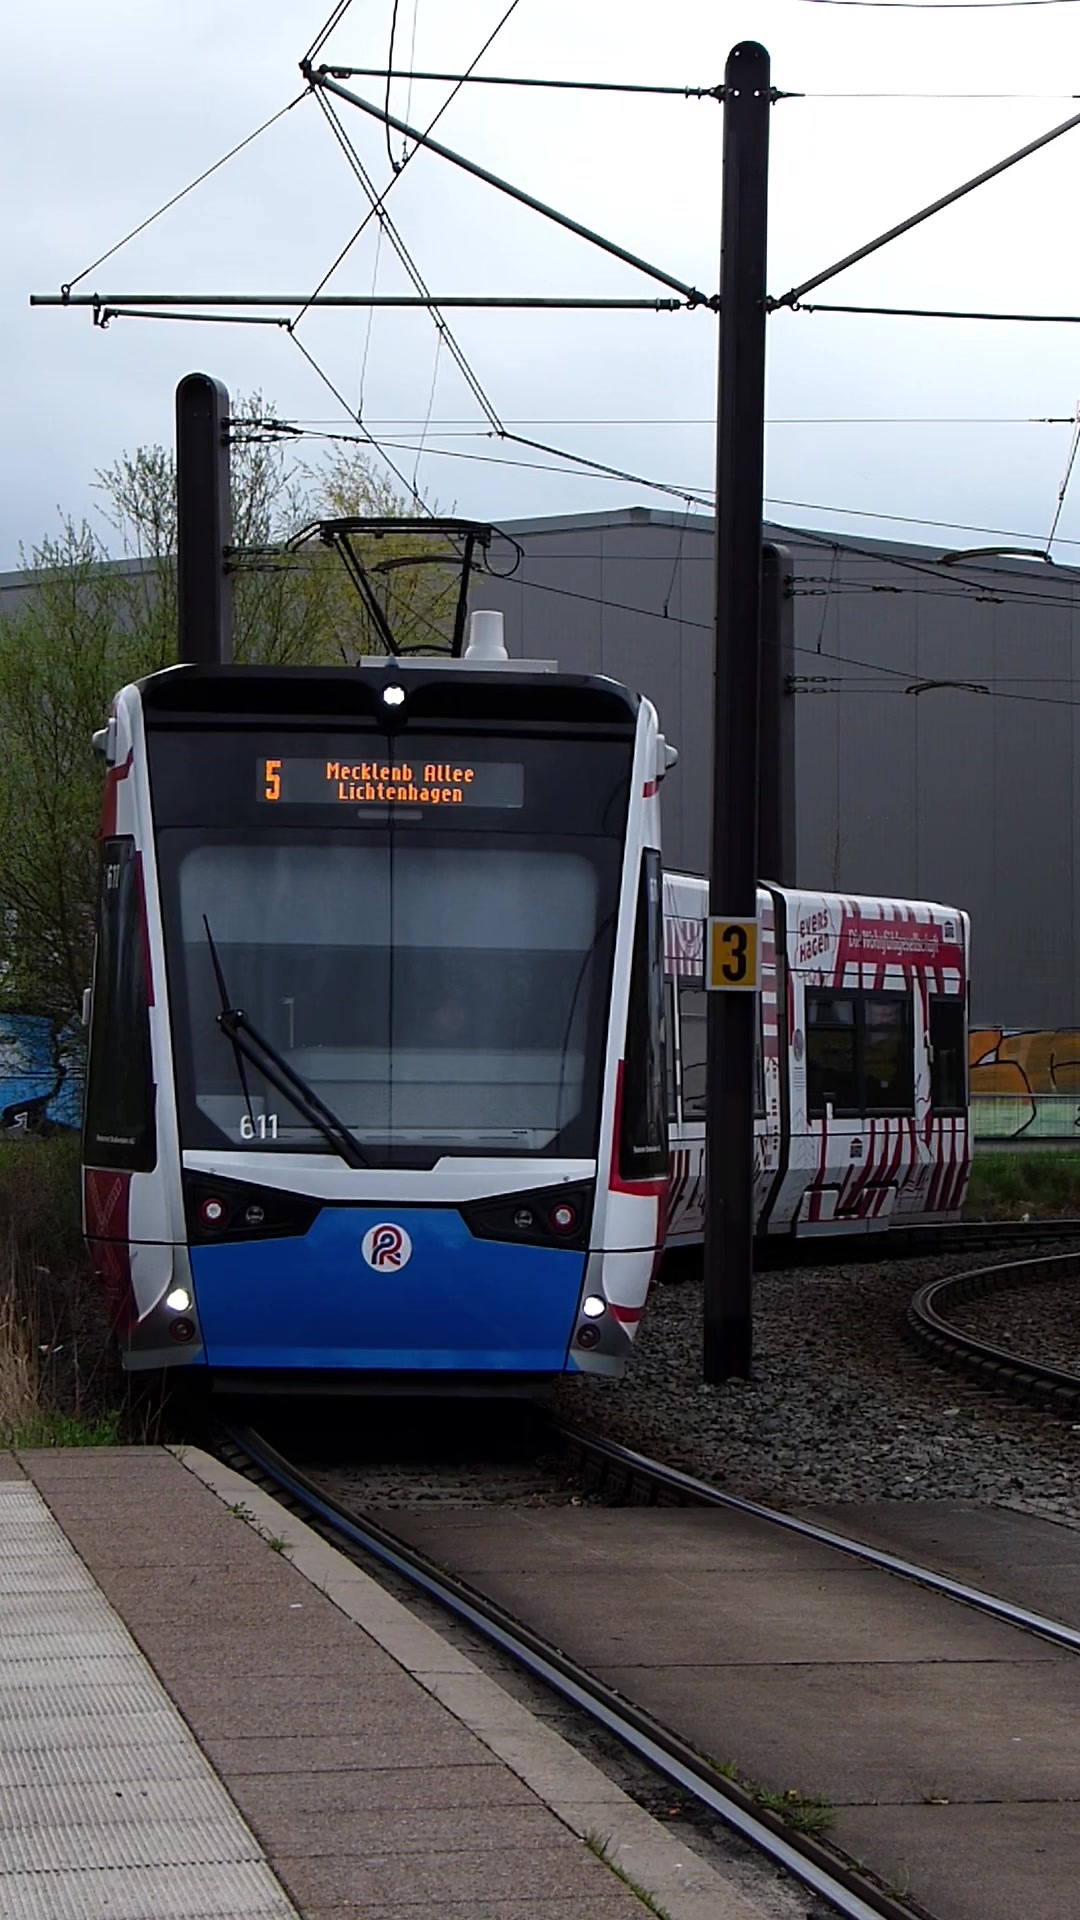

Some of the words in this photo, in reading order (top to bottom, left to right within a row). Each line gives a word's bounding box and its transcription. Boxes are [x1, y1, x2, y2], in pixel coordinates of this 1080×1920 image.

[265, 760, 281, 800] 5
[424, 765, 474, 782] Allee
[338, 783, 463, 803] Lichtenhagen
[722, 925, 748, 981] 3
[240, 1114, 278, 1140] 611
